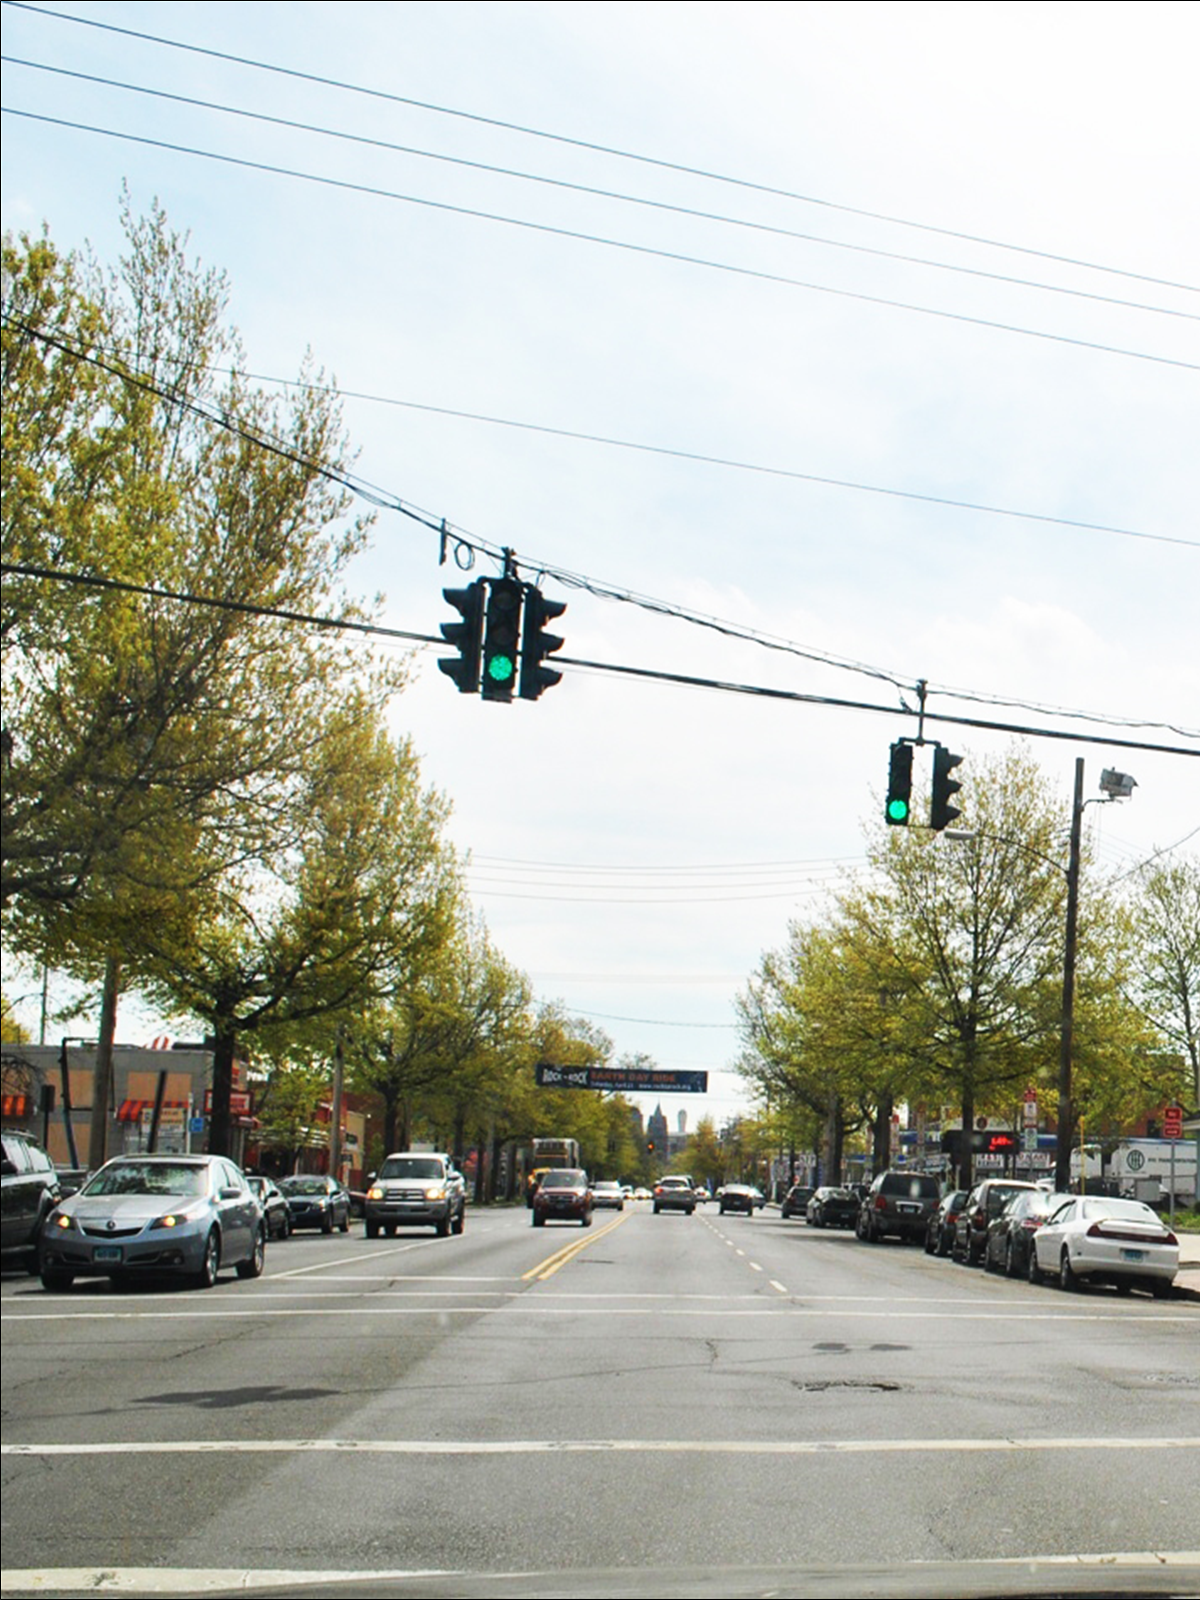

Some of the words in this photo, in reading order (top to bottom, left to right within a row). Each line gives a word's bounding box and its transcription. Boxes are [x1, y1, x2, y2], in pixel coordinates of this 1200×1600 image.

[542, 1068, 562, 1083] ROCK
[567, 1070, 588, 1084] ROCK
[590, 1071, 625, 1081] EARTH
[628, 1073, 649, 1082] DAY
[652, 1074, 675, 1082] RIDE
